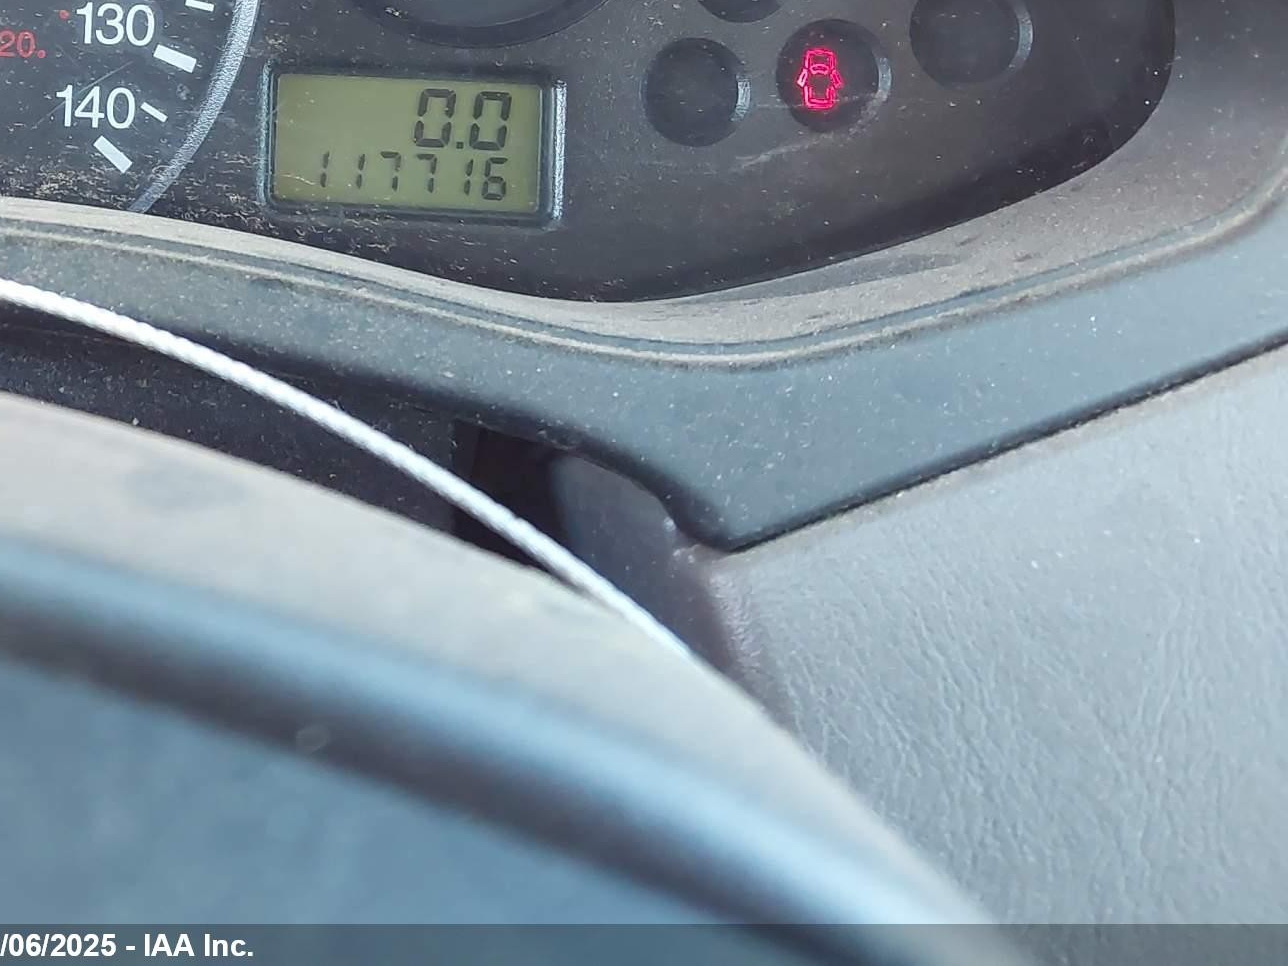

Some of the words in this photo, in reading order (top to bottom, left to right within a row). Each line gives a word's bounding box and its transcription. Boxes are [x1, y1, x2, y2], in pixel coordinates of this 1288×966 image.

[76, 1, 155, 46] 130
[56, 84, 135, 129] 140
[414, 88, 512, 151] 0.0
[320, 151, 508, 200] 117716
